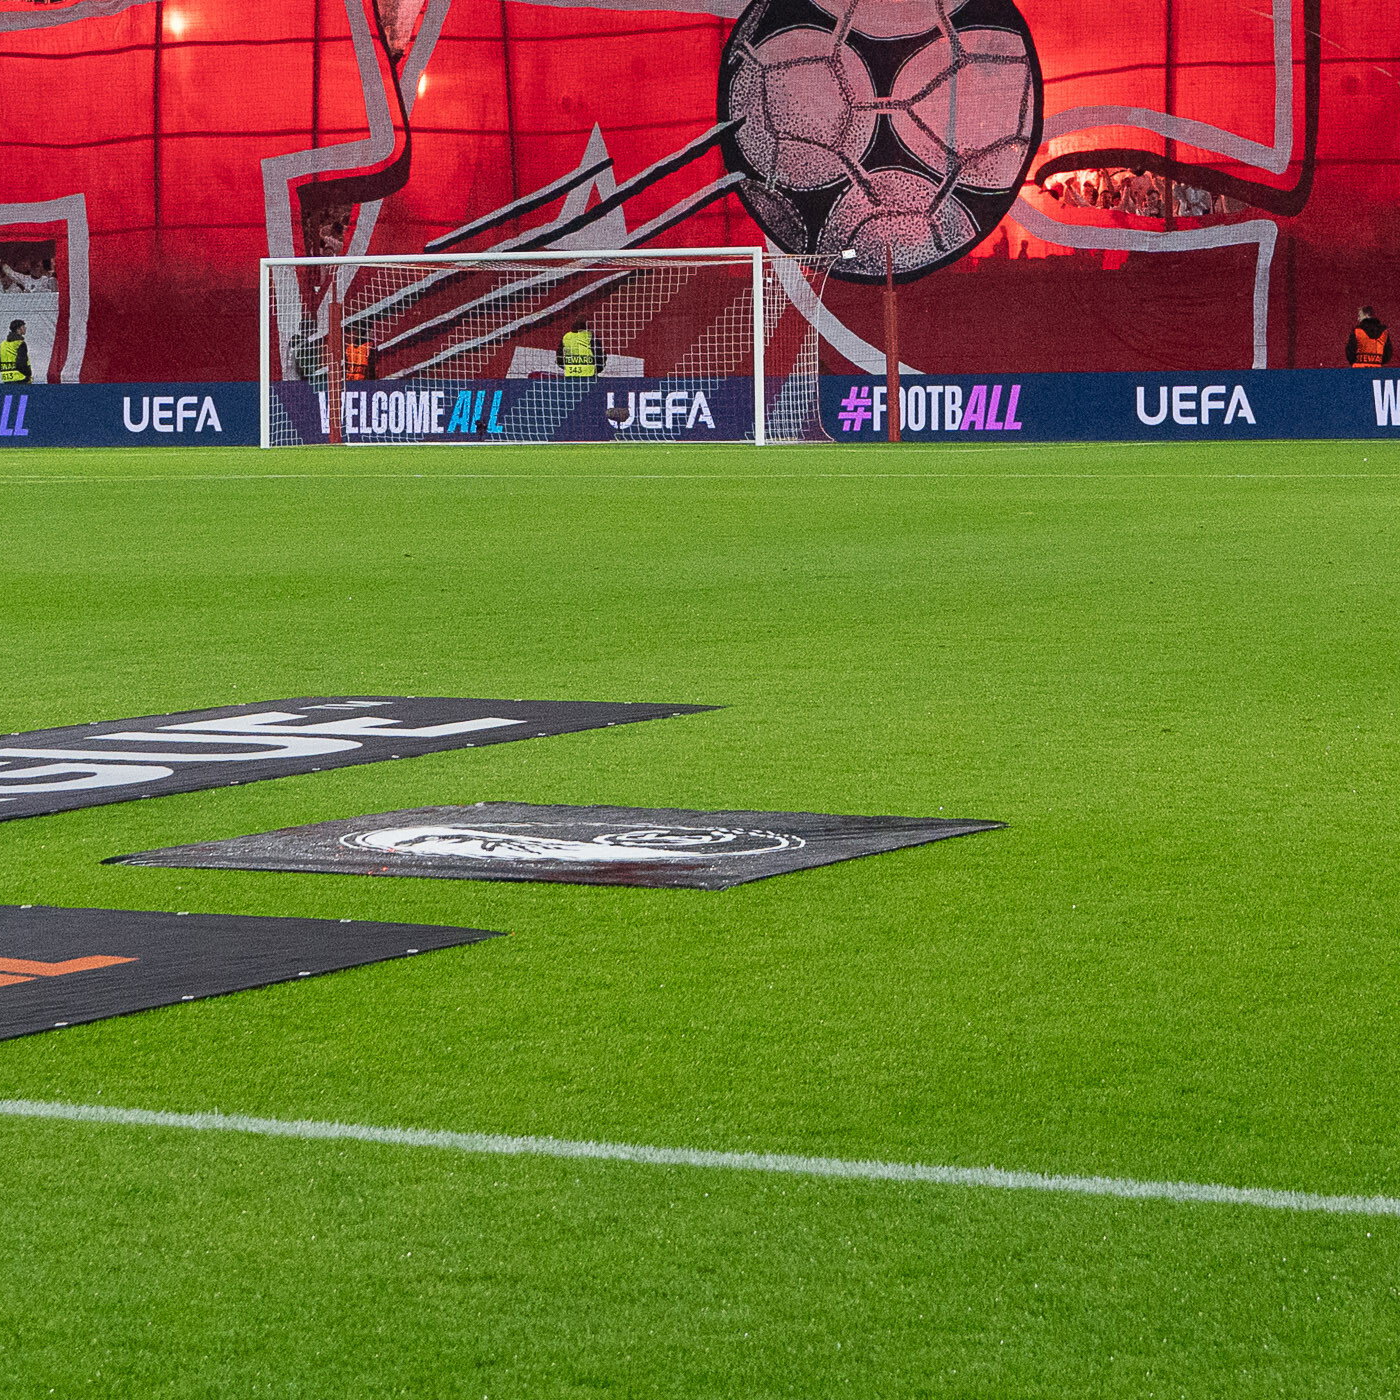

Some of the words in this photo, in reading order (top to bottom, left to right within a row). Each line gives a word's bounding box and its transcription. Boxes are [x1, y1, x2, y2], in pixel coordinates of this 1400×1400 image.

[123, 396, 222, 433] UEFA
[318, 390, 445, 435] WELCOME
[447, 389, 504, 434] ALL
[605, 392, 716, 429] UEFA
[1136, 385, 1257, 425] UEFA
